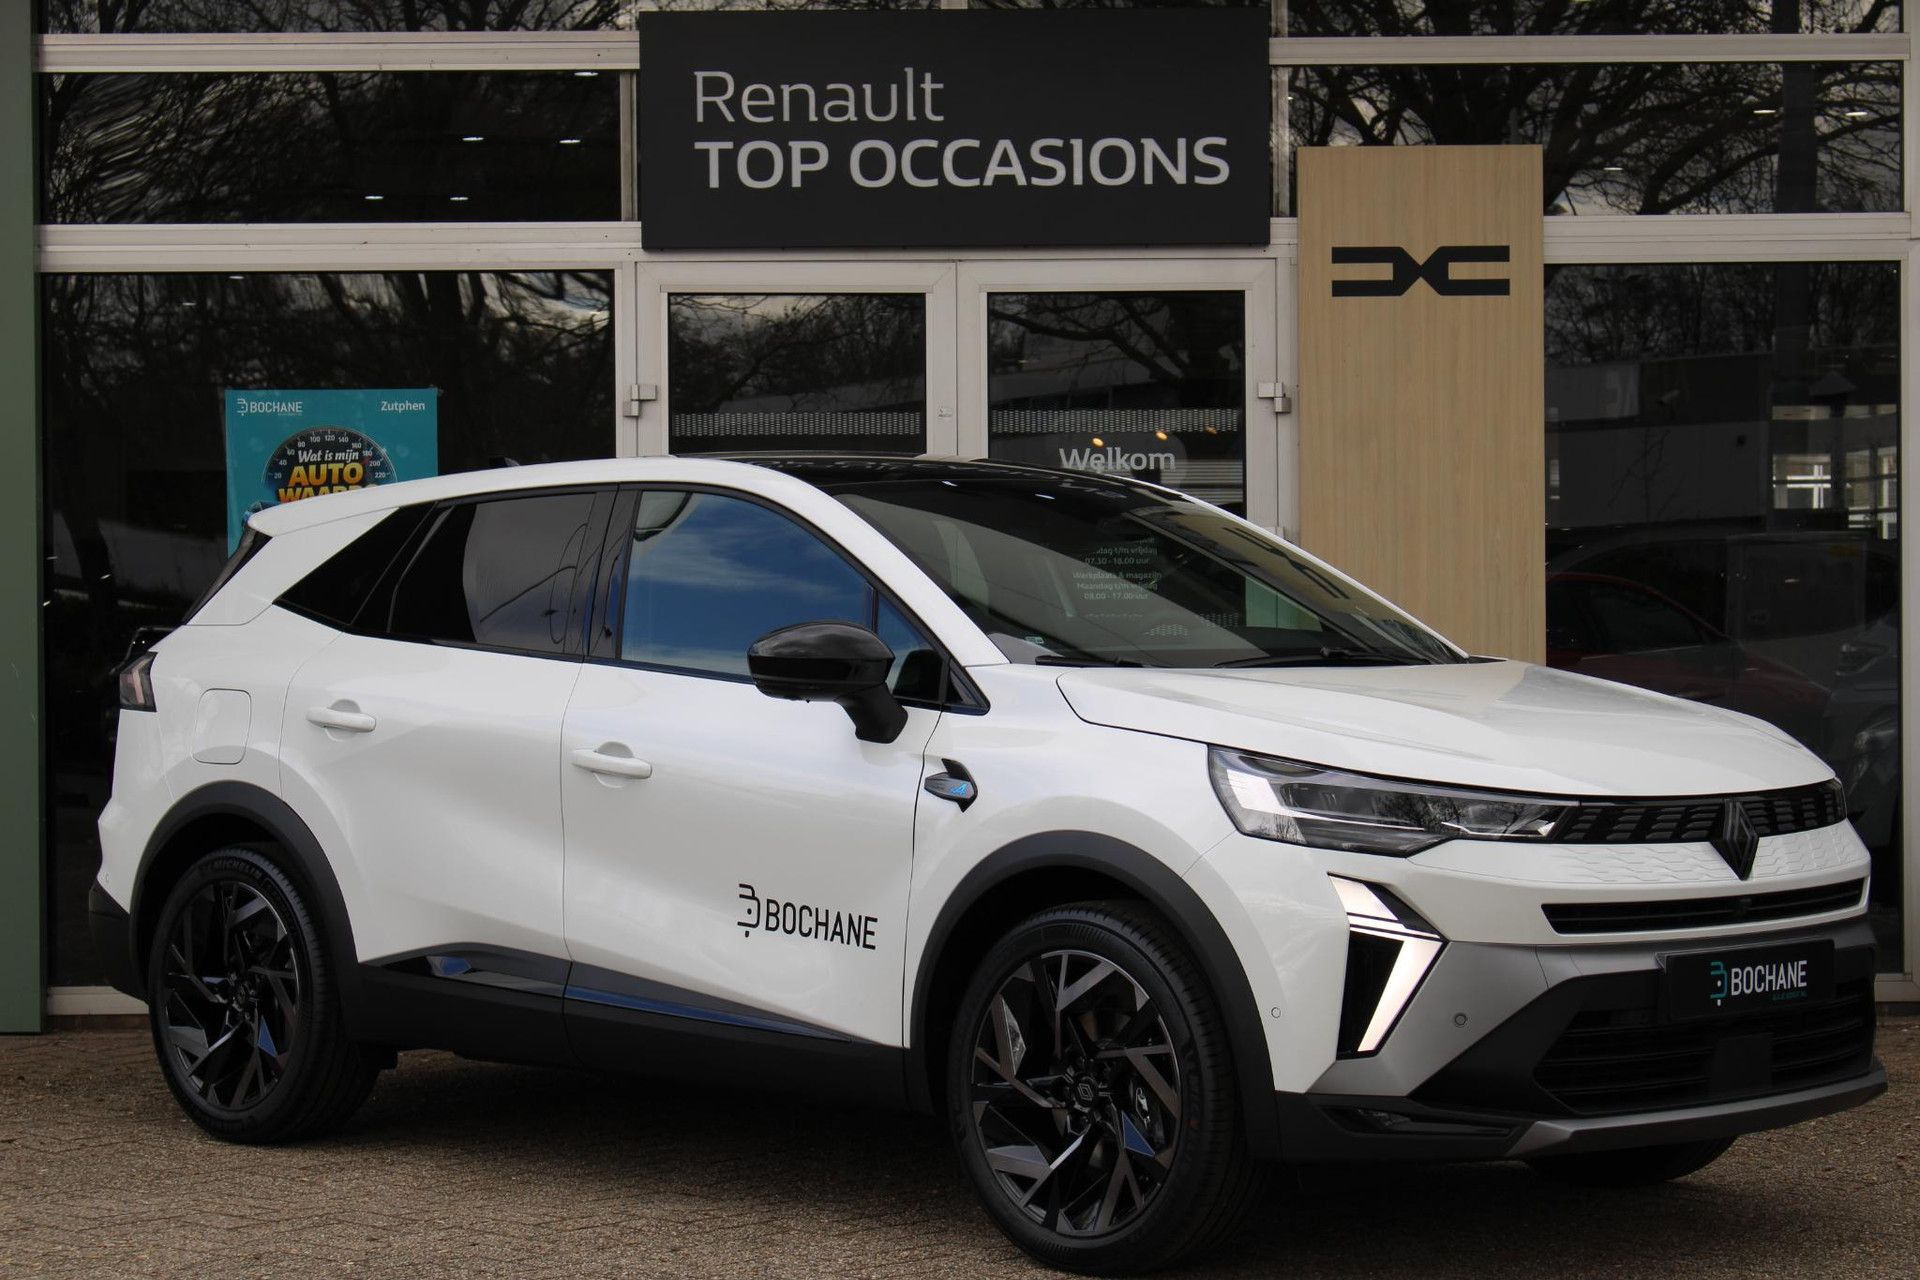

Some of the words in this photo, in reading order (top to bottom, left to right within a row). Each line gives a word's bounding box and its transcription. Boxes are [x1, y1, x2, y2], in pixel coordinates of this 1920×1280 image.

[694, 67, 945, 123] Renault
[694, 140, 829, 189] TOP
[850, 136, 1230, 188] OCCASIONS
[250, 402, 303, 413] BOCHANE
[381, 401, 425, 413] Zutphen
[298, 449, 321, 463] Wat
[325, 449, 333, 460] is
[335, 450, 359, 463] mijn
[1059, 446, 1176, 472] Welkom
[288, 462, 364, 487] AUTO
[765, 898, 878, 950] BOCHANE
[1731, 960, 1808, 995] BOCHANE
